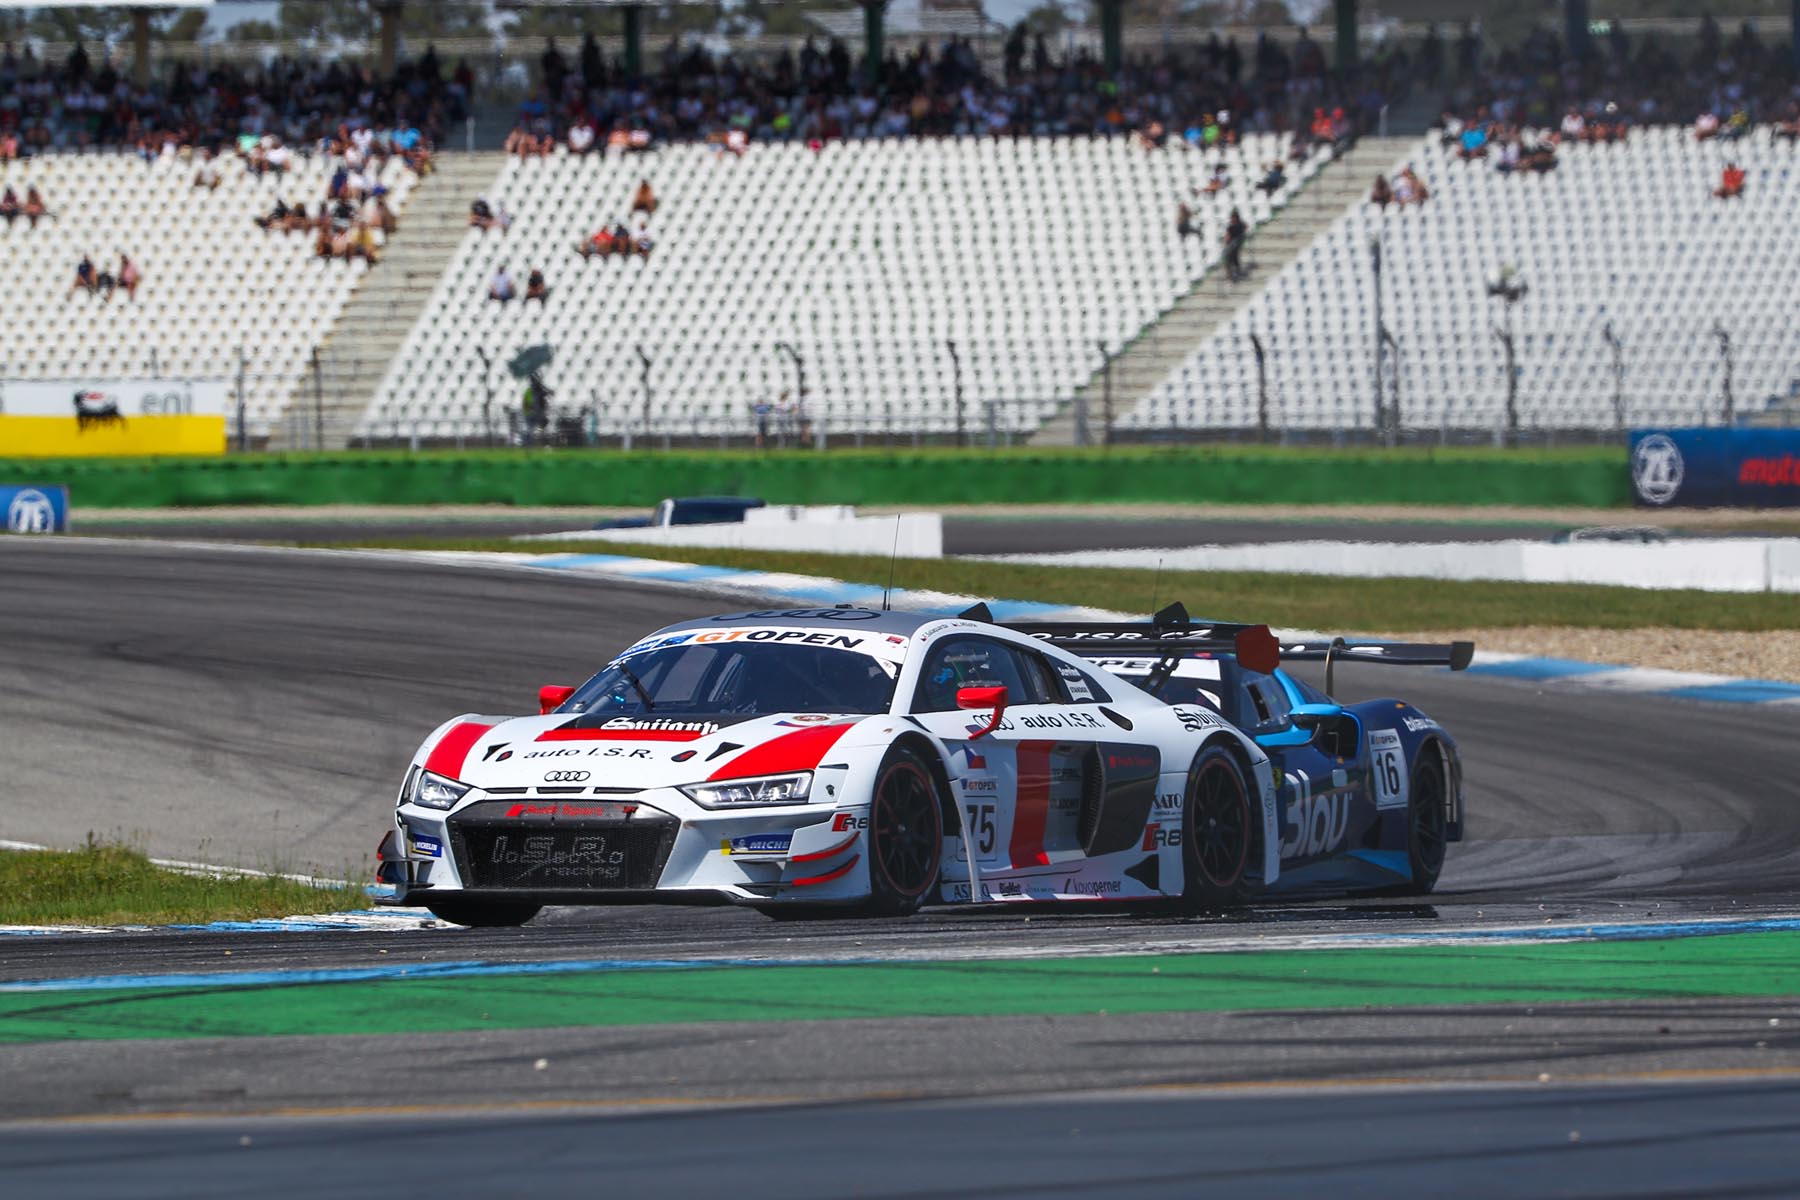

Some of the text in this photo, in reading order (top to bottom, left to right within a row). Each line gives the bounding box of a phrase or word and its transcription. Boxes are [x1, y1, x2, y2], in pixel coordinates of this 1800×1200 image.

[1021, 713, 1106, 729] auto I.S.R.
[524, 747, 654, 759] auto I.S.R.
[1376, 752, 1400, 796] 16
[526, 804, 603, 817] Audi Sport
[842, 816, 868, 829] R8
[967, 804, 995, 854] 75
[1154, 828, 1182, 847] R8
